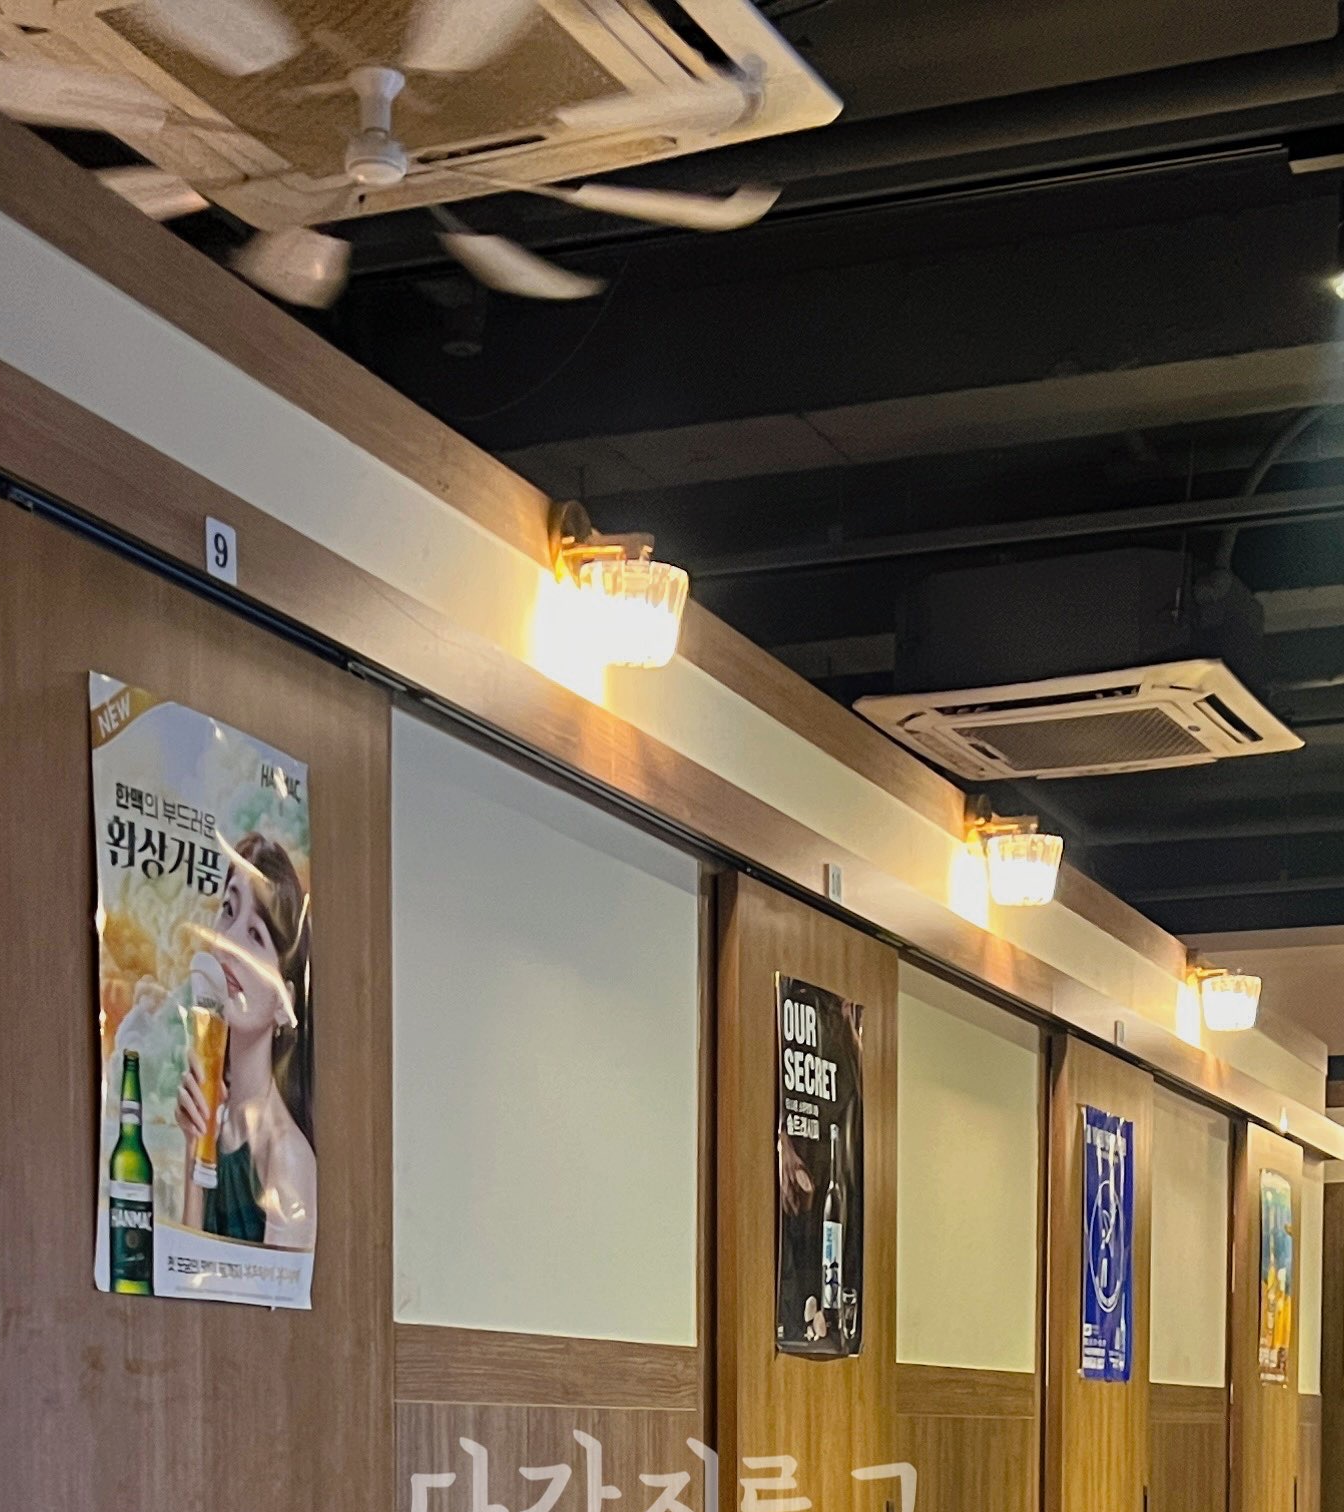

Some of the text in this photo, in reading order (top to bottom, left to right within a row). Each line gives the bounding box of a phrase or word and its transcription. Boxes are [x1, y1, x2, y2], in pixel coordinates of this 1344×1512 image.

[214, 532, 228, 568] 9
[97, 693, 131, 738] NEW
[115, 782, 216, 840] 한맥의 부드러운
[106, 814, 224, 897] 환상거품
[783, 998, 817, 1048] OUR
[783, 1048, 838, 1102] SECRET
